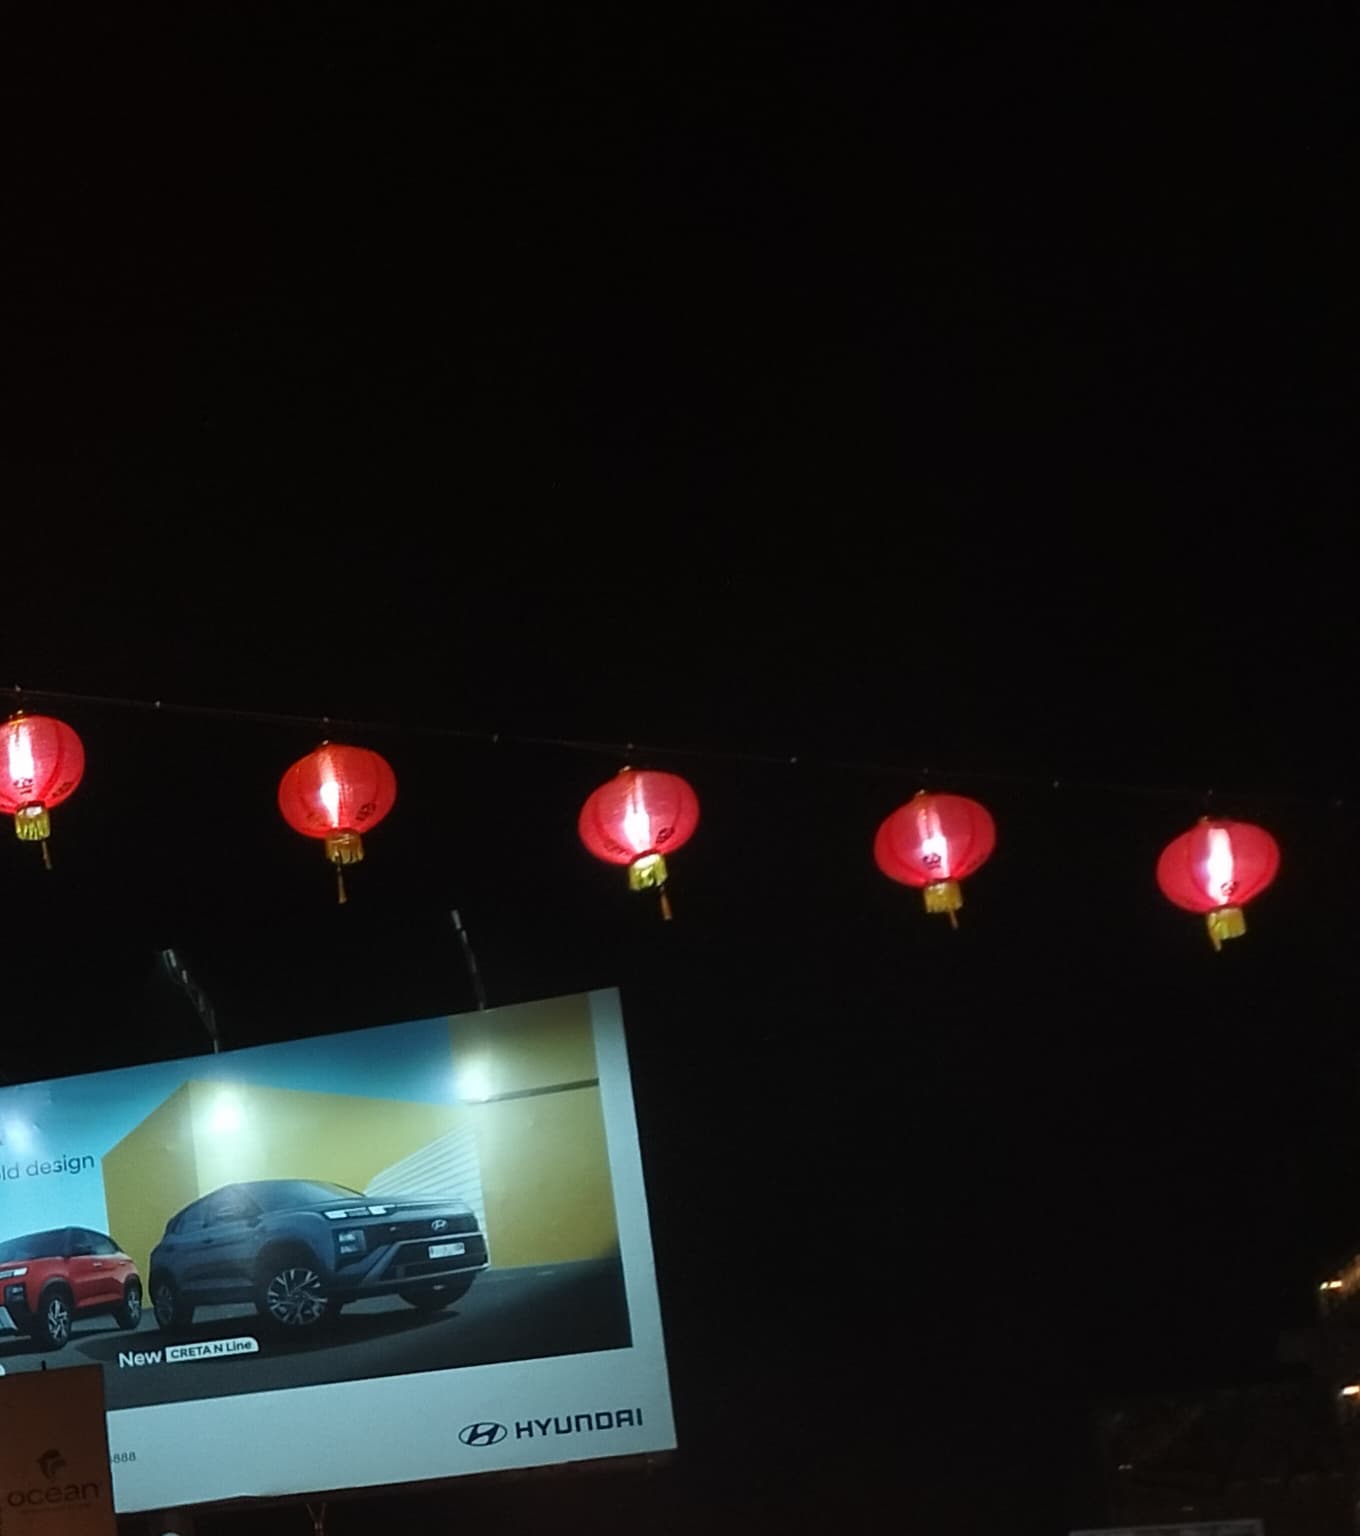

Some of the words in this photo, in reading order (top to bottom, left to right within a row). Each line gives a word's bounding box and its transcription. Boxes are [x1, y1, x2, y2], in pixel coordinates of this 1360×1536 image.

[25, 1153, 95, 1178] design
[119, 1350, 162, 1368] New
[170, 1344, 212, 1359] CRETA
[213, 1343, 224, 1354] N
[225, 1340, 252, 1353] Line
[515, 1408, 643, 1439] HYUNDAI
[7, 1482, 100, 1507] ocean
